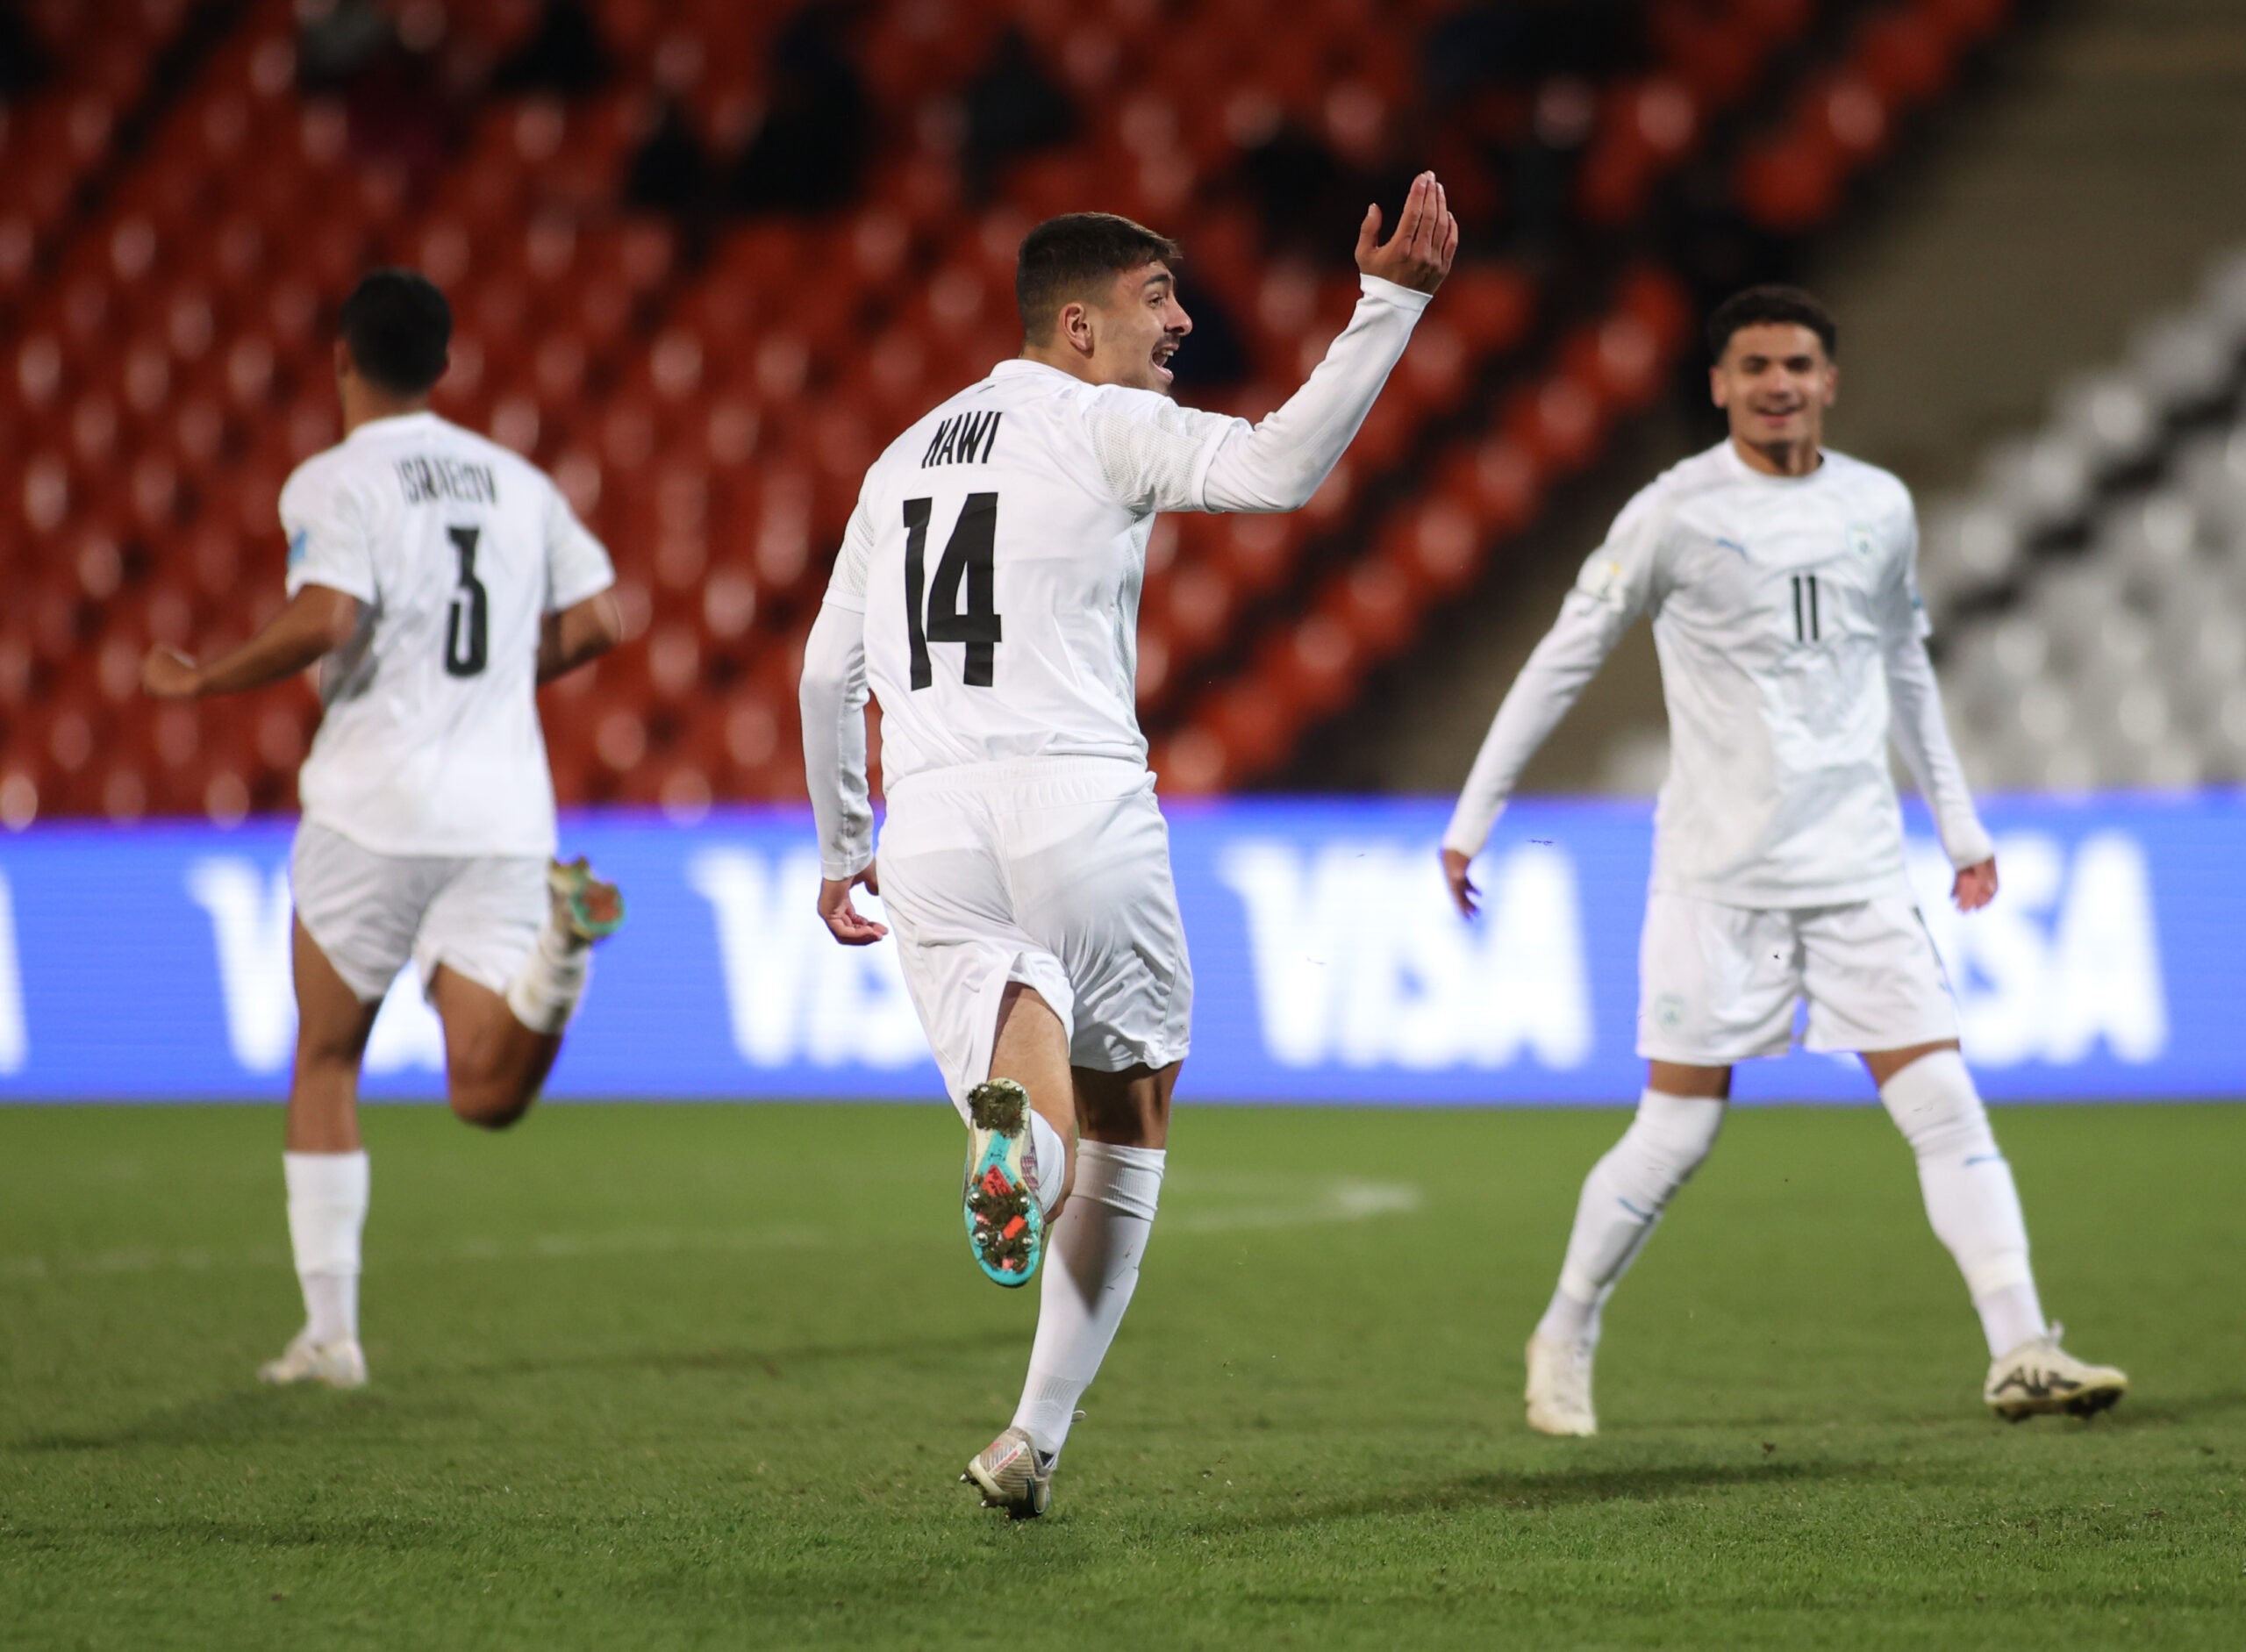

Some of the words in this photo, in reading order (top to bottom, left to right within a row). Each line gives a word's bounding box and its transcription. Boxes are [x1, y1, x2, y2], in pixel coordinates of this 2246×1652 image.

[922, 410, 1003, 469] NAWI
[445, 526, 489, 678] 3
[903, 491, 1002, 691] 14
[1792, 576, 1820, 642] 11
[1215, 839, 1595, 1069] VISA
